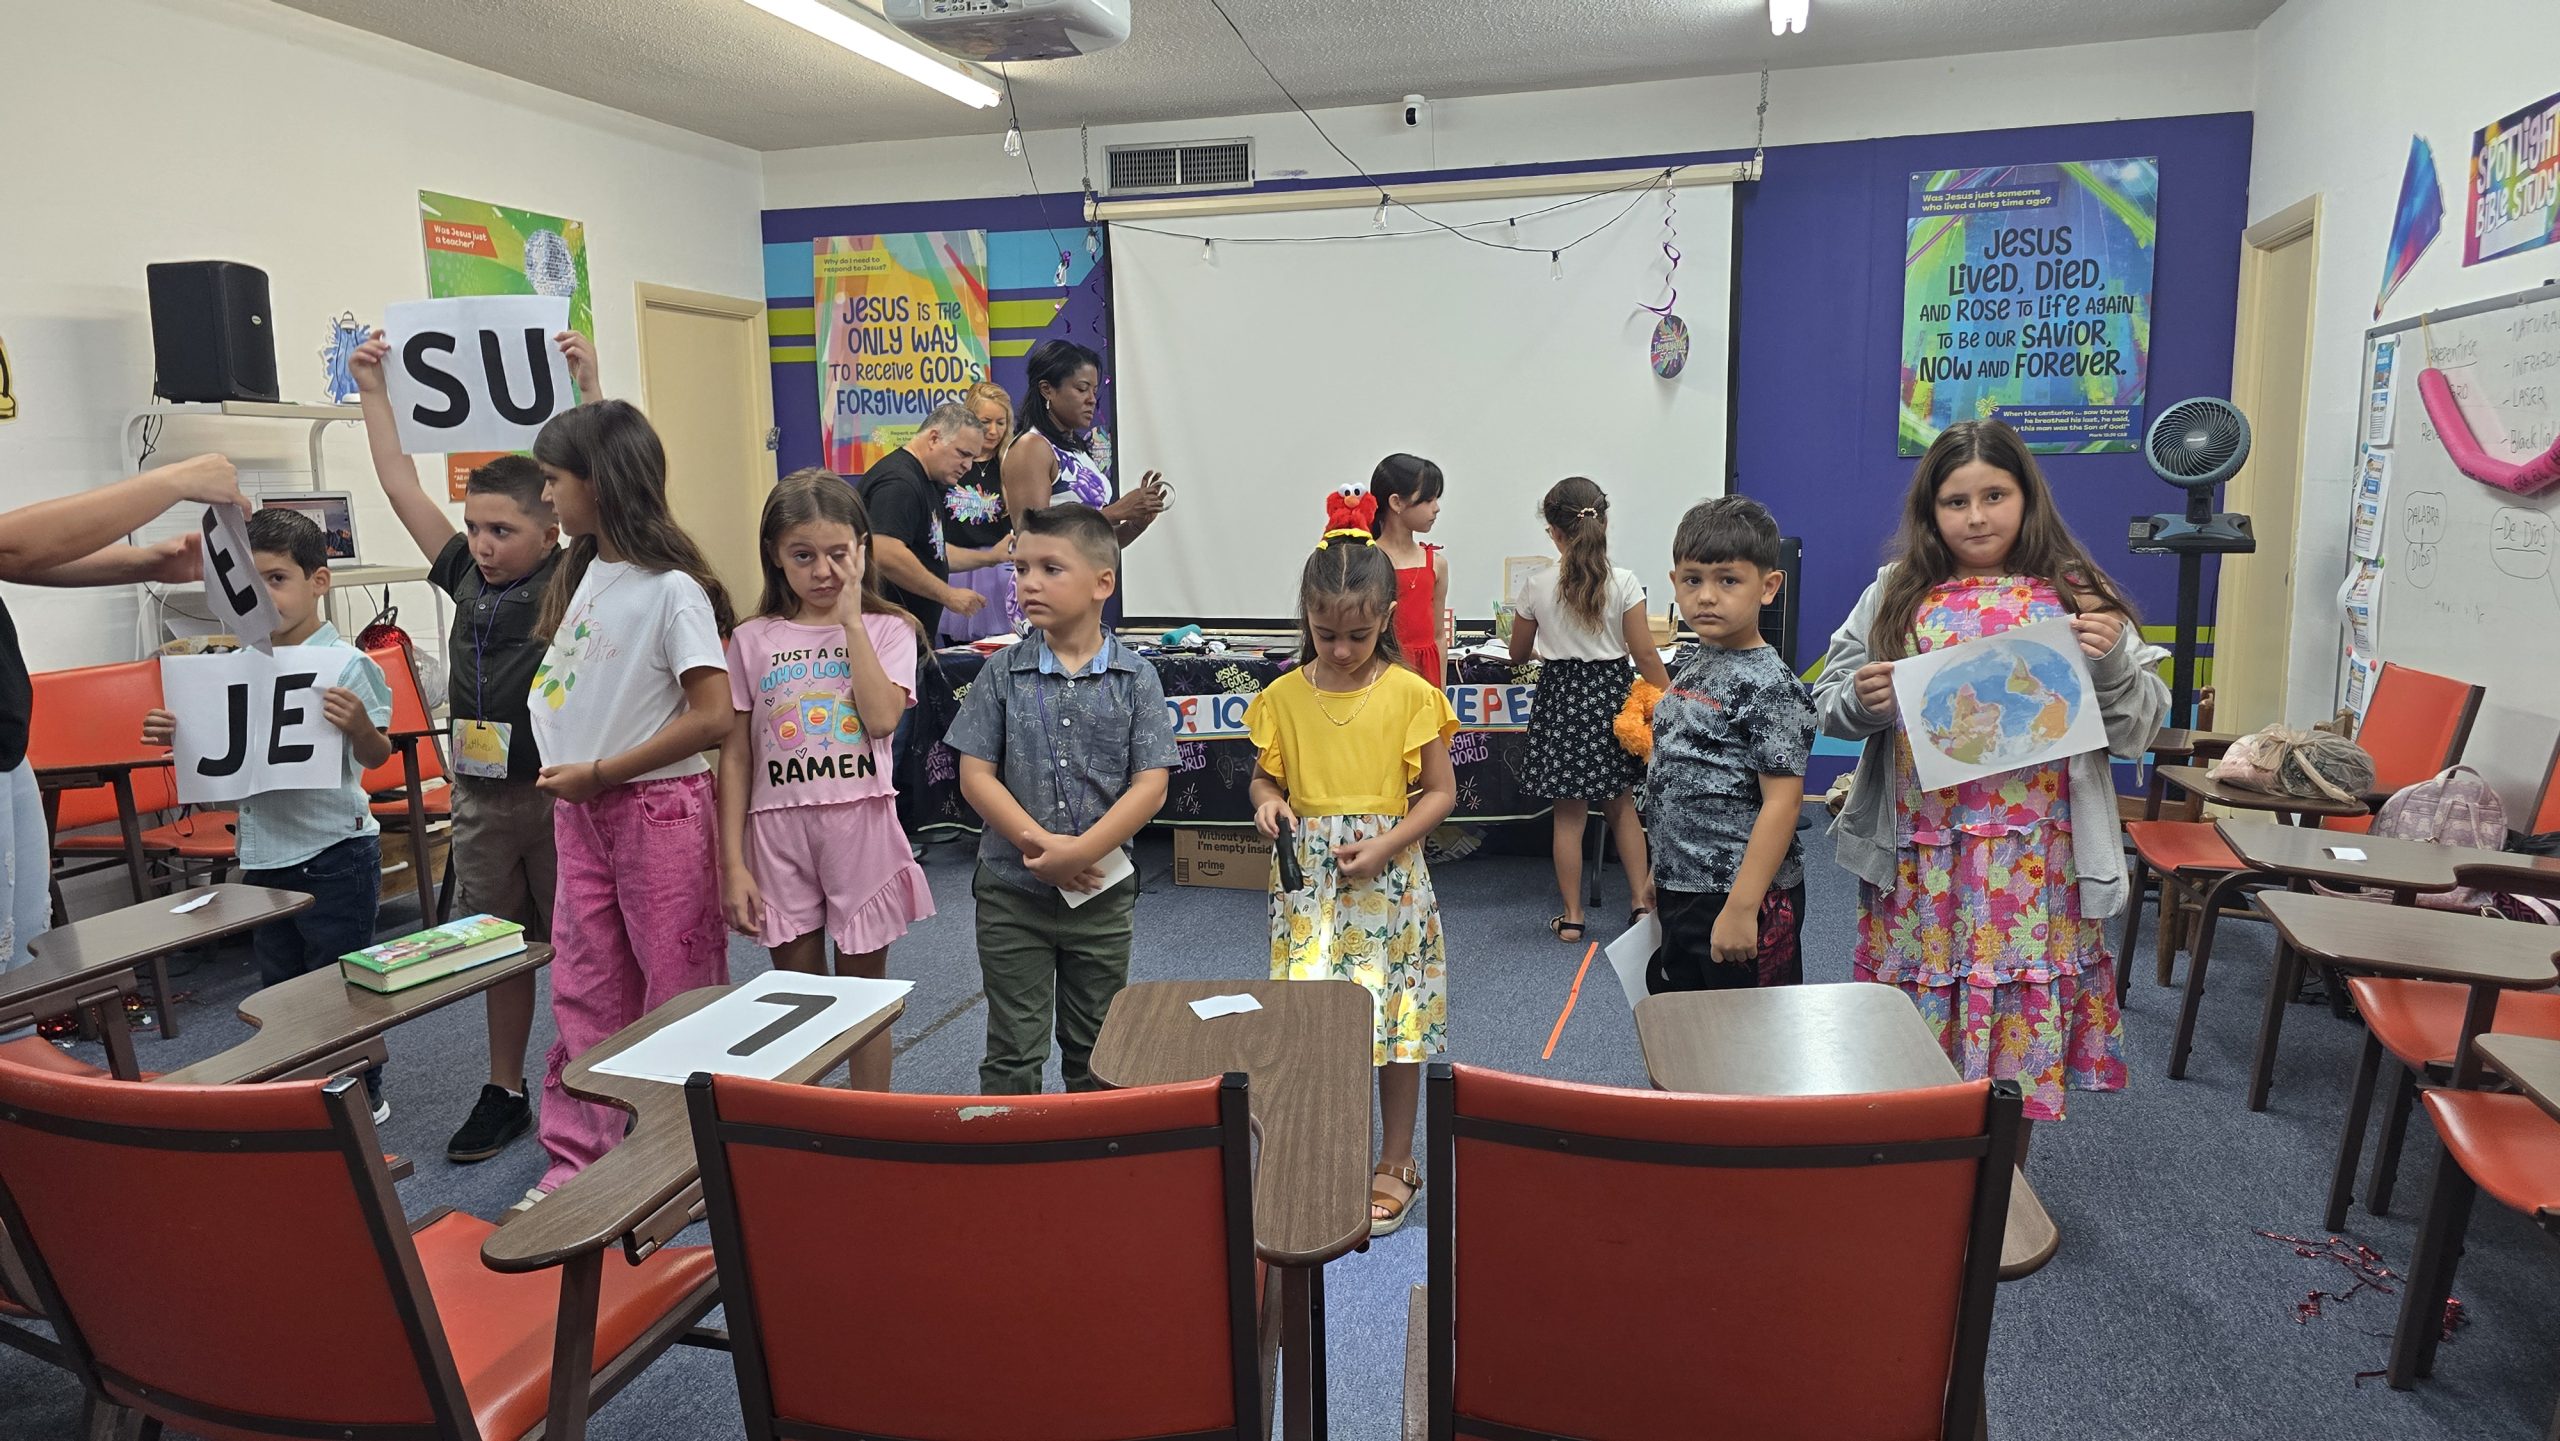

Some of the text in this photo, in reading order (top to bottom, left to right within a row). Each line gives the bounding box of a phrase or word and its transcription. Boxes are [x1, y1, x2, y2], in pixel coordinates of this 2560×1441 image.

[1921, 196, 2052, 212] who lived a long time ago?
[1922, 188, 2041, 203] Was Jesus just someone
[2474, 162, 2559, 238] BIBLE STUDY
[433, 224, 488, 243] Was Jesus just
[441, 235, 475, 249] teacher?
[1983, 225, 2072, 260] JESUS
[853, 256, 872, 264] need
[862, 264, 887, 272] Jesus?
[1949, 258, 2105, 296] LIVED, DIED,
[843, 295, 909, 325] JESUS
[935, 301, 962, 321] THE
[1919, 294, 2134, 322] AND ROSE TO LIFE AGAIN
[848, 323, 958, 356] ONLY WAY
[1937, 319, 2112, 350] TO BE OUR SAVIOR,
[402, 327, 555, 429] SU
[829, 356, 981, 383] TO RECEIVE GOD'S
[1919, 349, 2127, 383] NOW AND FOREVER.
[201, 505, 258, 617] E
[771, 647, 850, 667] JUST A GI
[760, 661, 853, 693] WHO LOV
[196, 672, 318, 777] JE
[767, 752, 877, 788] RAMEN
[1181, 754, 1207, 772] ORLD
[1197, 830, 1261, 844] Without you,
[1197, 841, 1273, 855] I'm empty insid
[1197, 860, 1225, 870] prime
